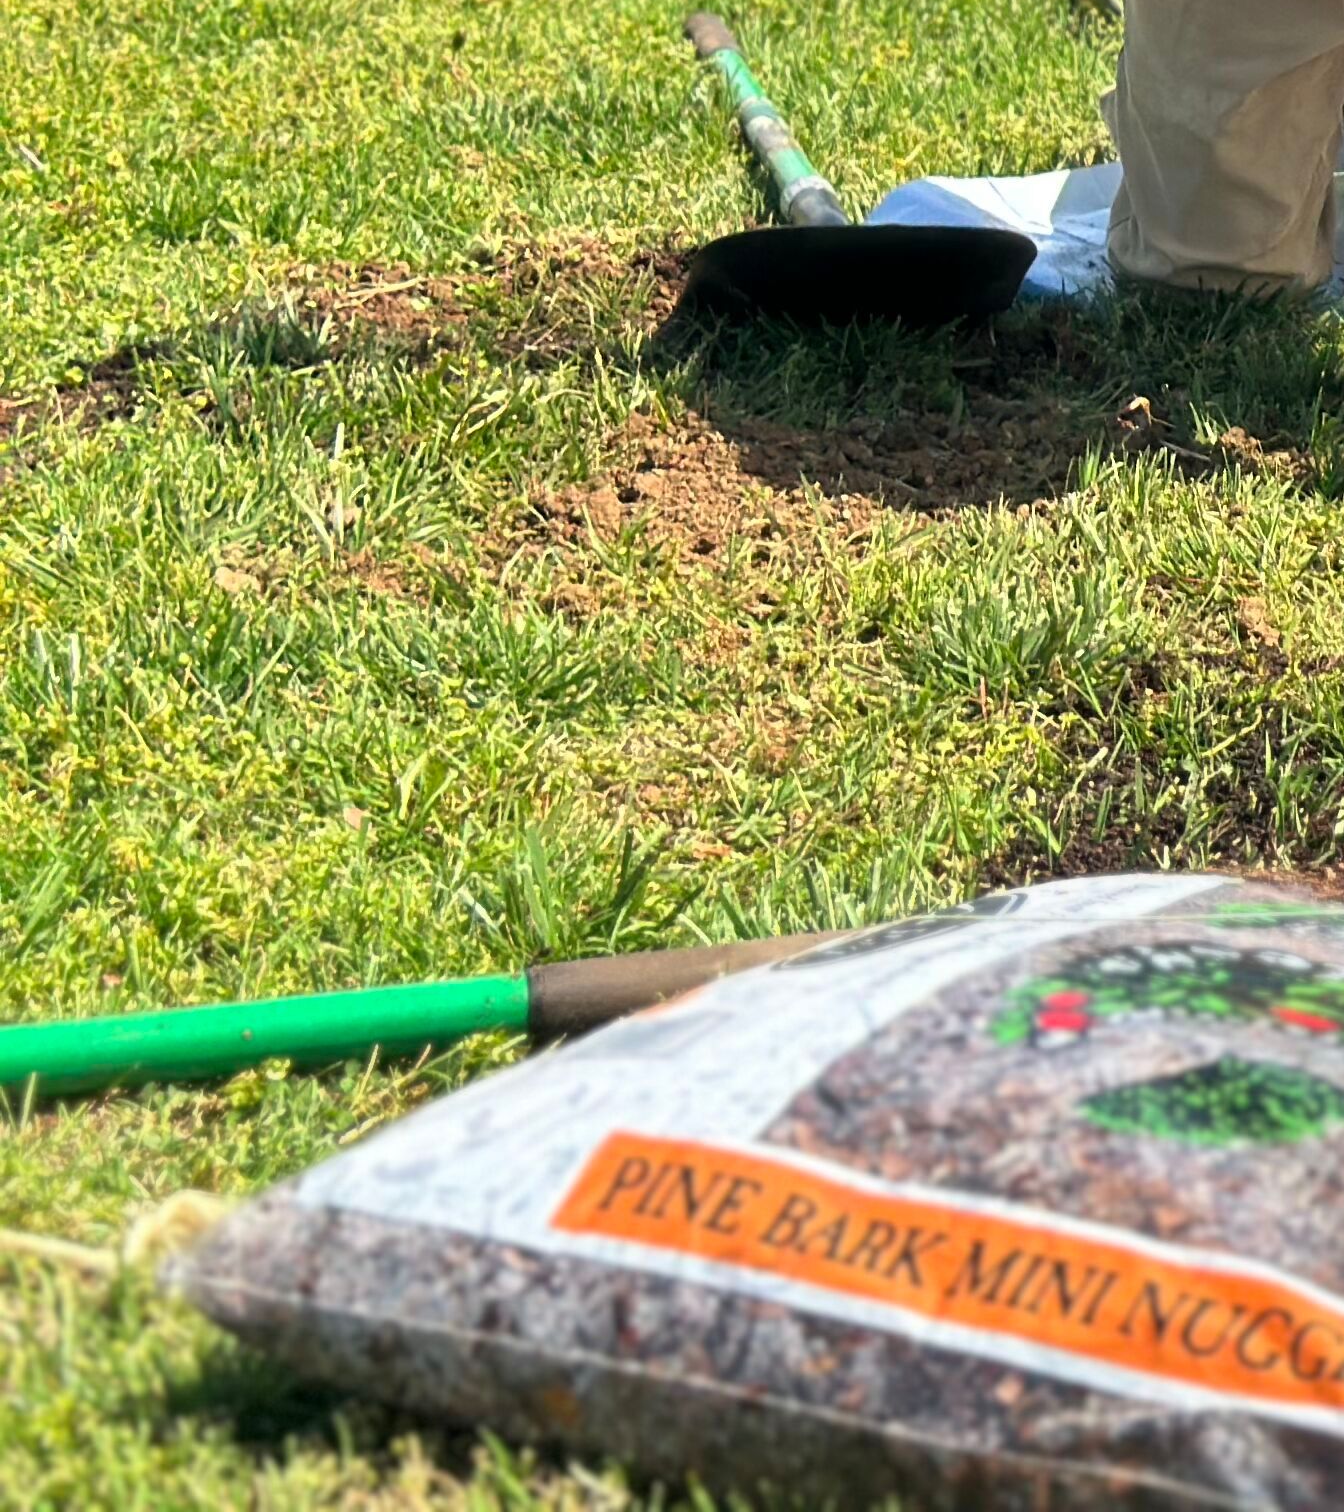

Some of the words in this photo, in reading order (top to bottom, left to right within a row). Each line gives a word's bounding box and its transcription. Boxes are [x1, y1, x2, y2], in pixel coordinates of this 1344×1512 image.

[598, 1154, 762, 1236] PINE
[758, 1192, 947, 1287] BARK
[943, 1238, 1105, 1325] MINI
